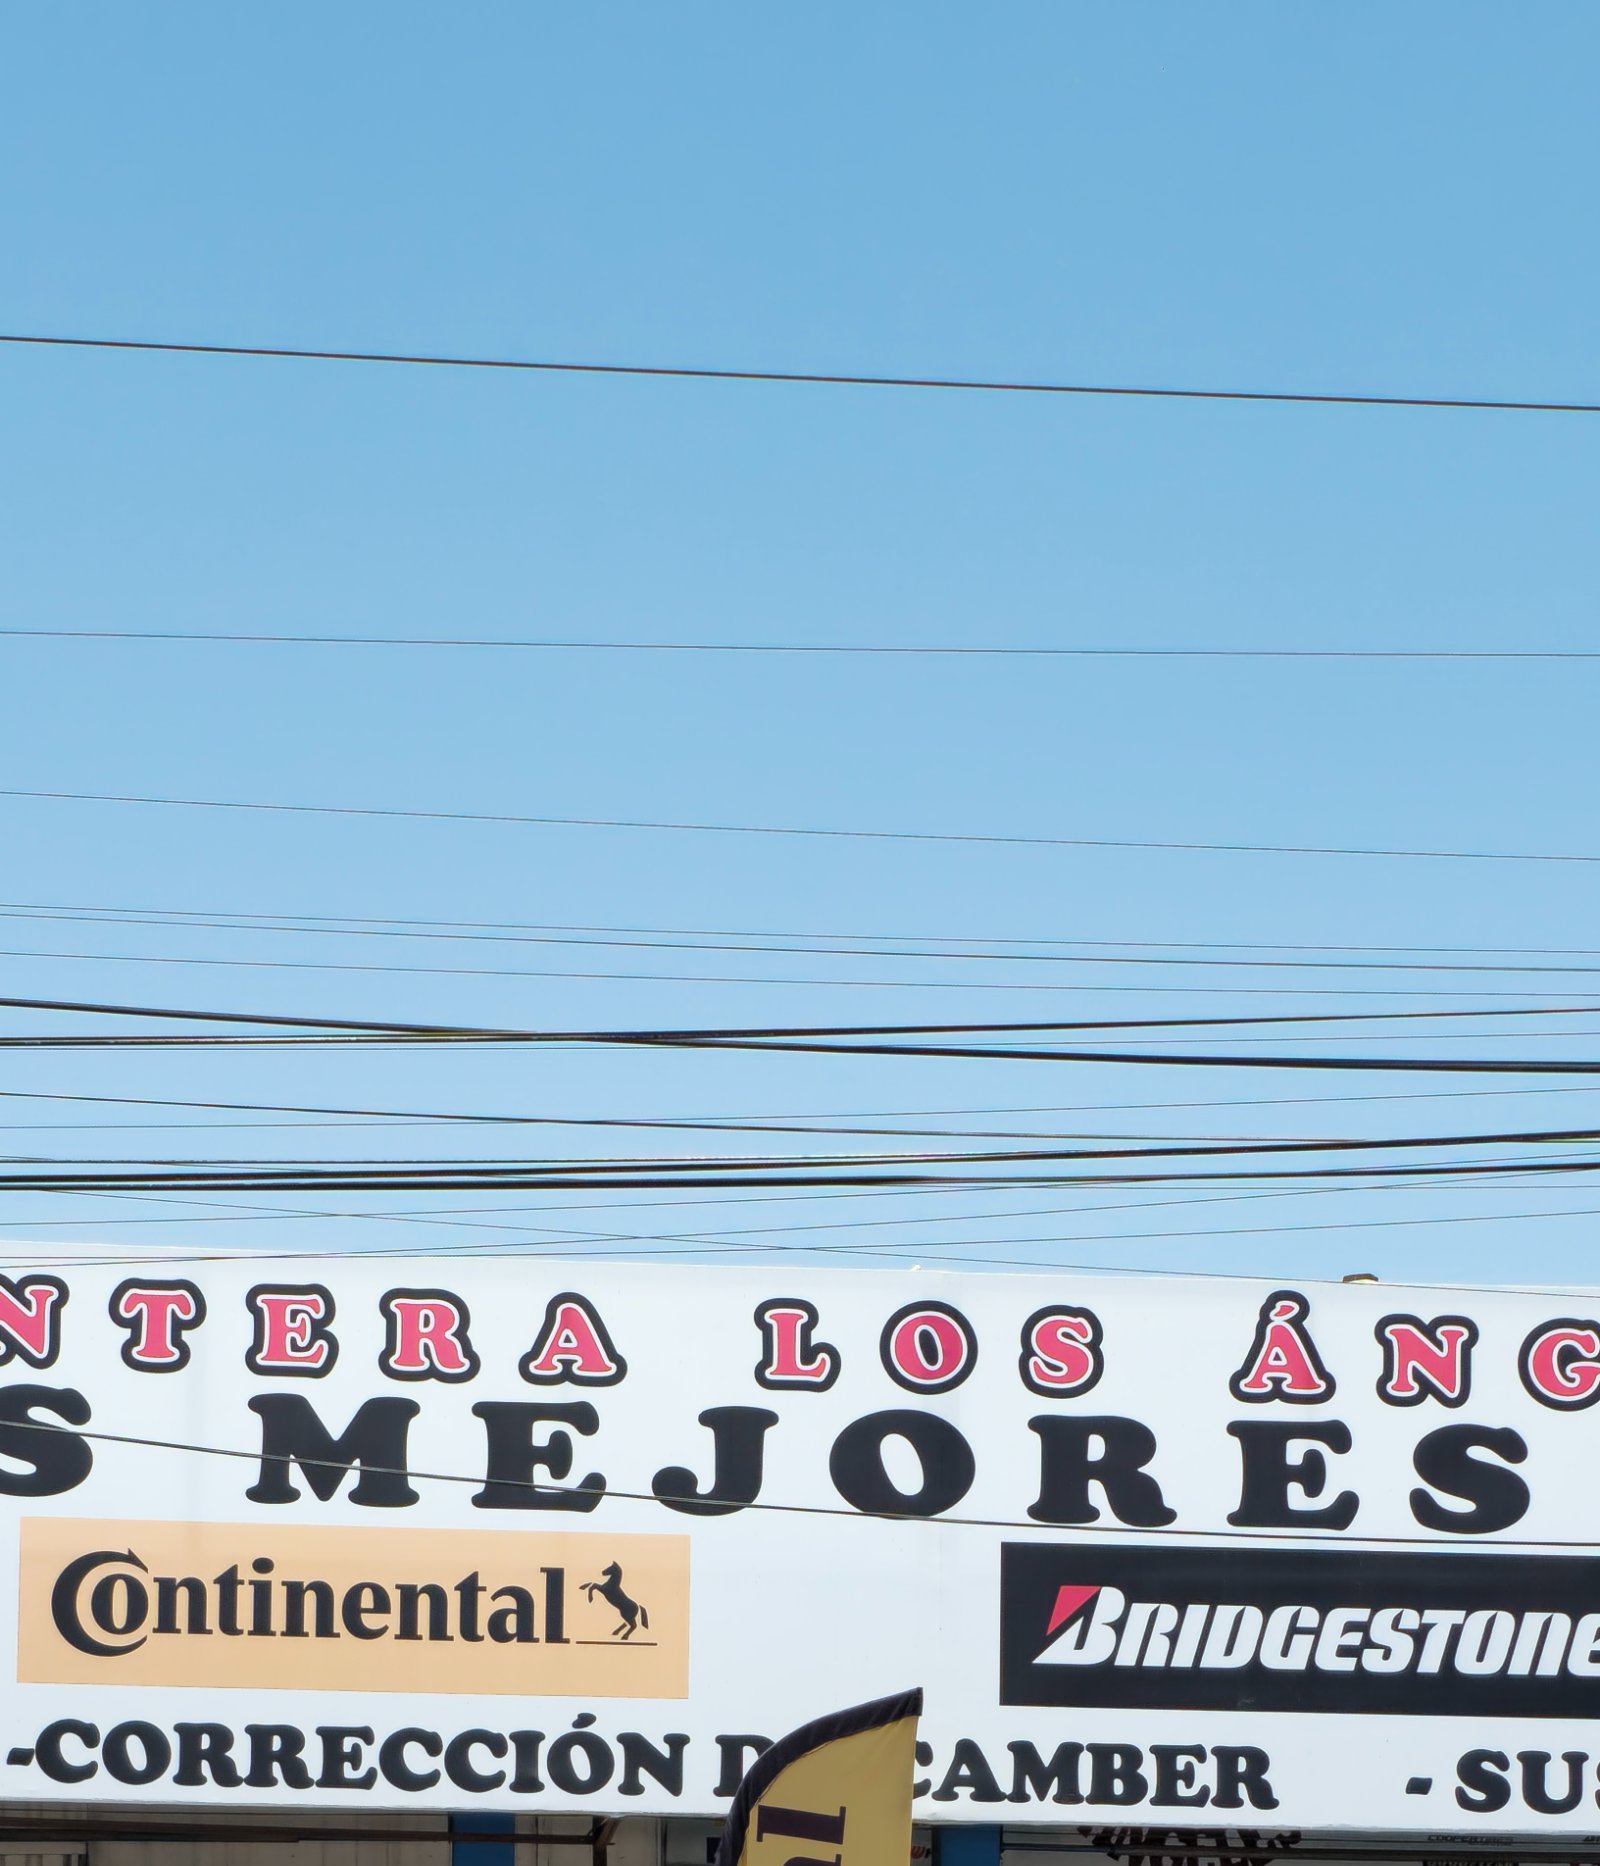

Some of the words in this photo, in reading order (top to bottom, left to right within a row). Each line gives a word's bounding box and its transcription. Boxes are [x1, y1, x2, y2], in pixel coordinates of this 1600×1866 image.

[754, 1297, 1103, 1398] LOS
[245, 1393, 1531, 1535] MEJORES
[51, 1547, 572, 1657] Continental
